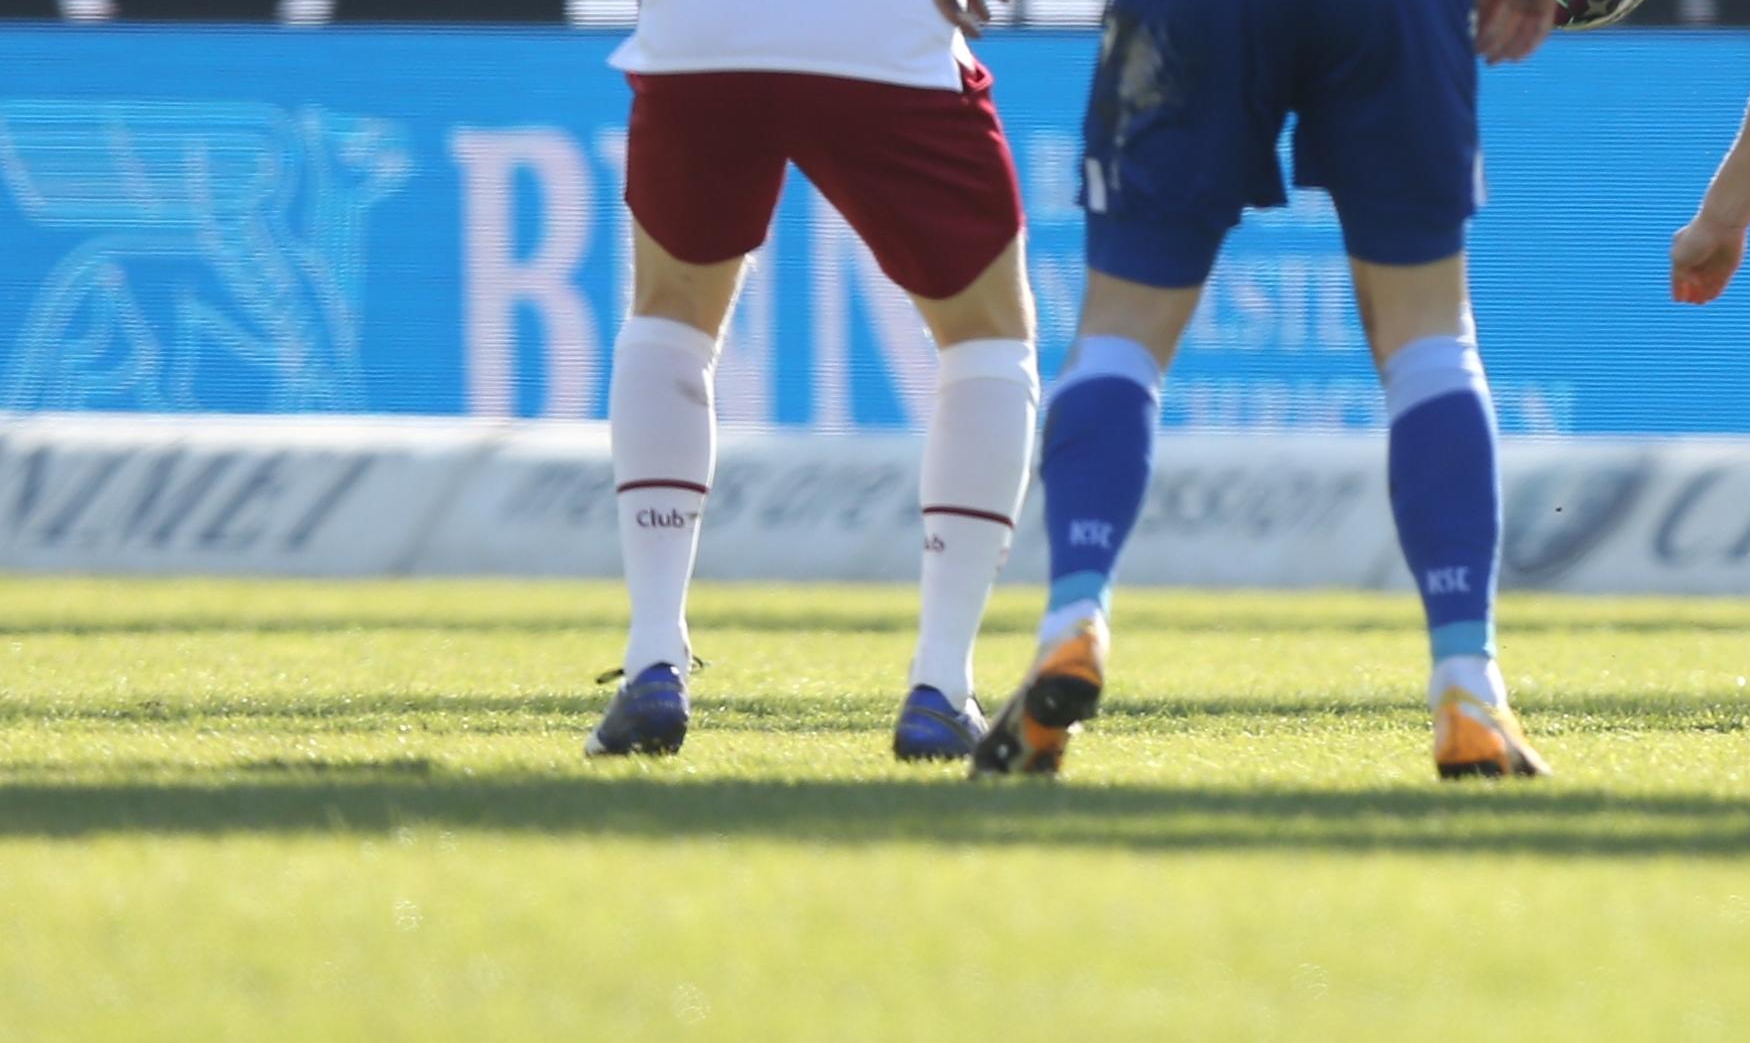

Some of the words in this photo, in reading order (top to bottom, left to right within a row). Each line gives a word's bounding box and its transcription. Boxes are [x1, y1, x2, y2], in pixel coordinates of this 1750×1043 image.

[636, 508, 685, 529] Club
[1069, 518, 1114, 548] KSC
[1426, 565, 1471, 595] KSC
